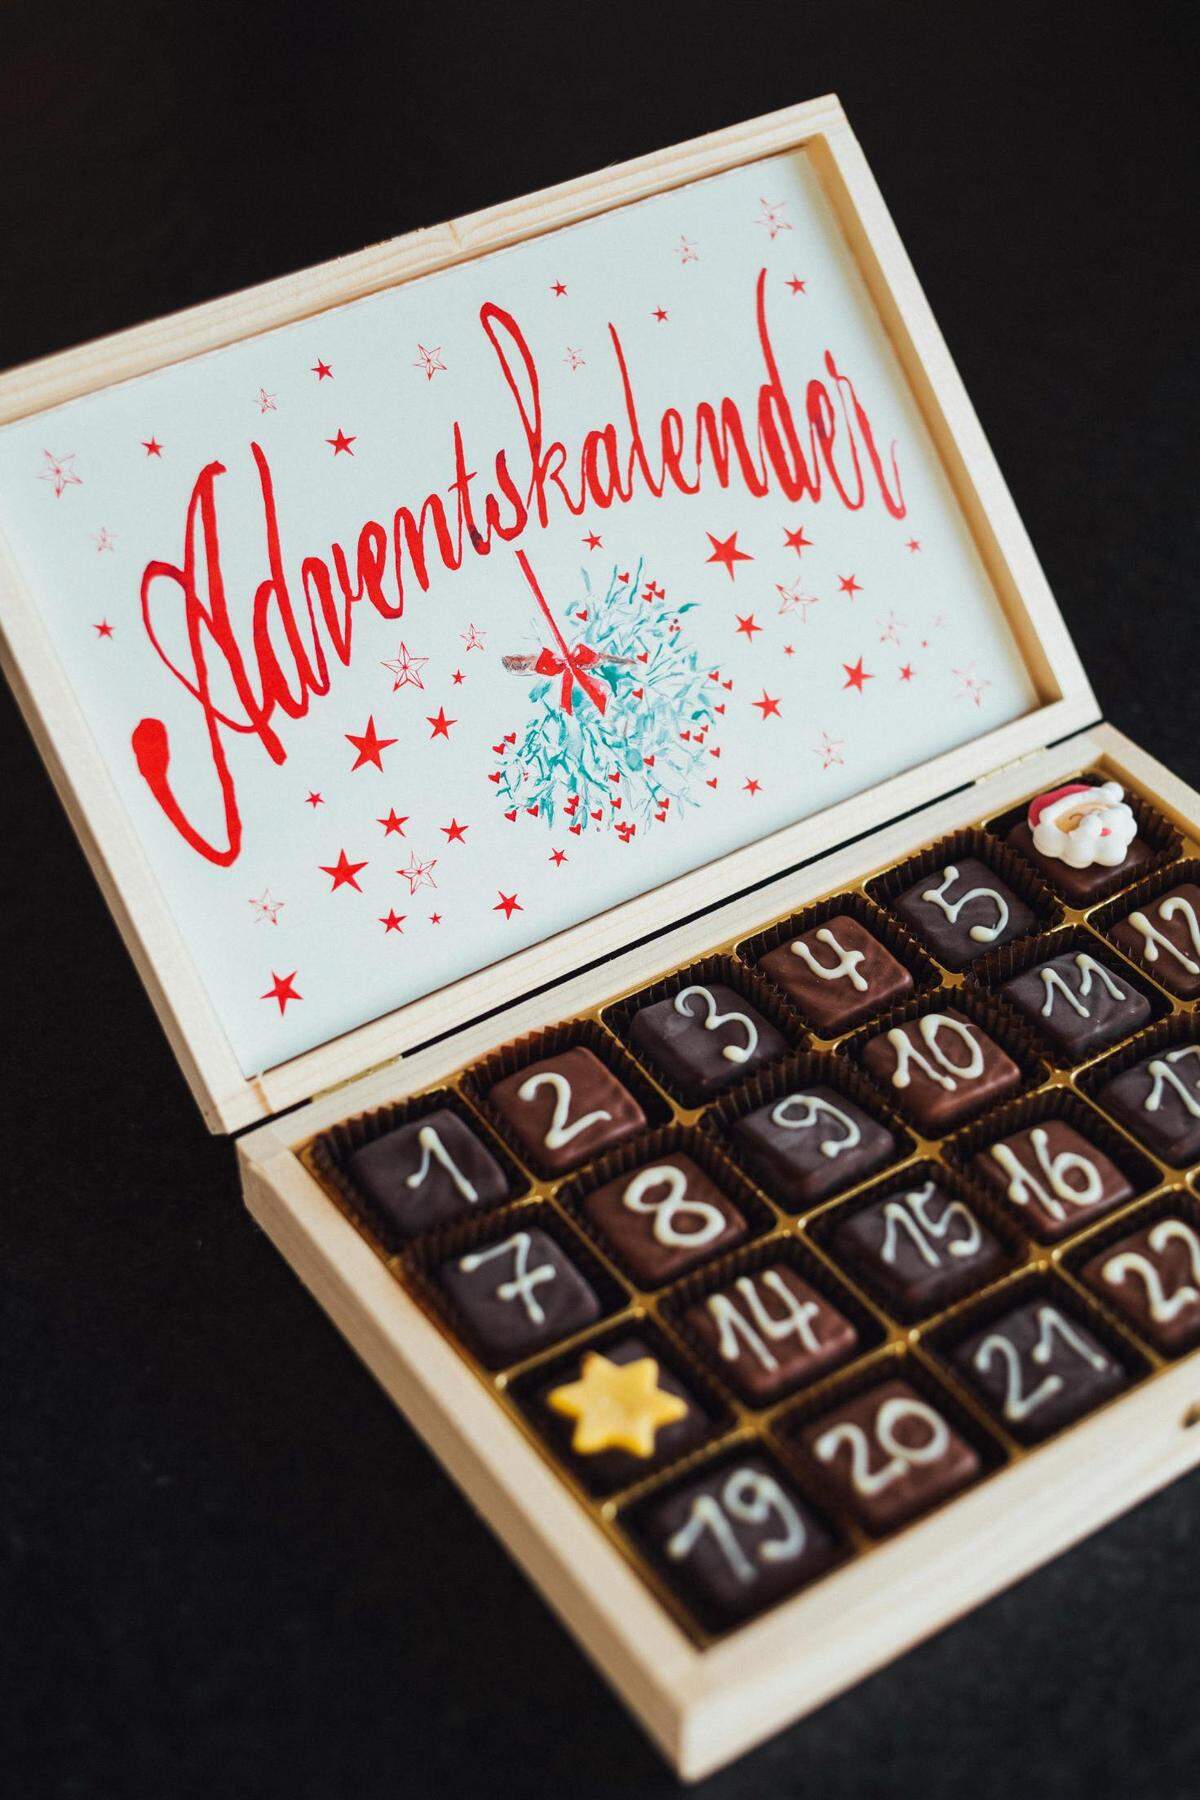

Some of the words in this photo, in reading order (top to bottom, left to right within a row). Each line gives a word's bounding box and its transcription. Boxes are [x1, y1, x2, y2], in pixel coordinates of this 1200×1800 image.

[131, 267, 907, 868] Adventskalender
[922, 865, 1009, 943] 5
[790, 928, 869, 992] 4
[1040, 953, 1127, 1018] 11
[674, 985, 759, 1064] 3
[887, 1013, 985, 1092] 10
[517, 1072, 612, 1150] 2
[771, 1094, 861, 1158] 9
[406, 1126, 479, 1203] 1
[622, 1164, 727, 1248] 8
[991, 1128, 1103, 1222] 16
[881, 1181, 982, 1268] 15
[459, 1232, 556, 1326] 7
[708, 1270, 820, 1374] 14
[973, 1306, 1109, 1421] 21
[813, 1397, 953, 1497] 20
[666, 1467, 807, 1584] 19
